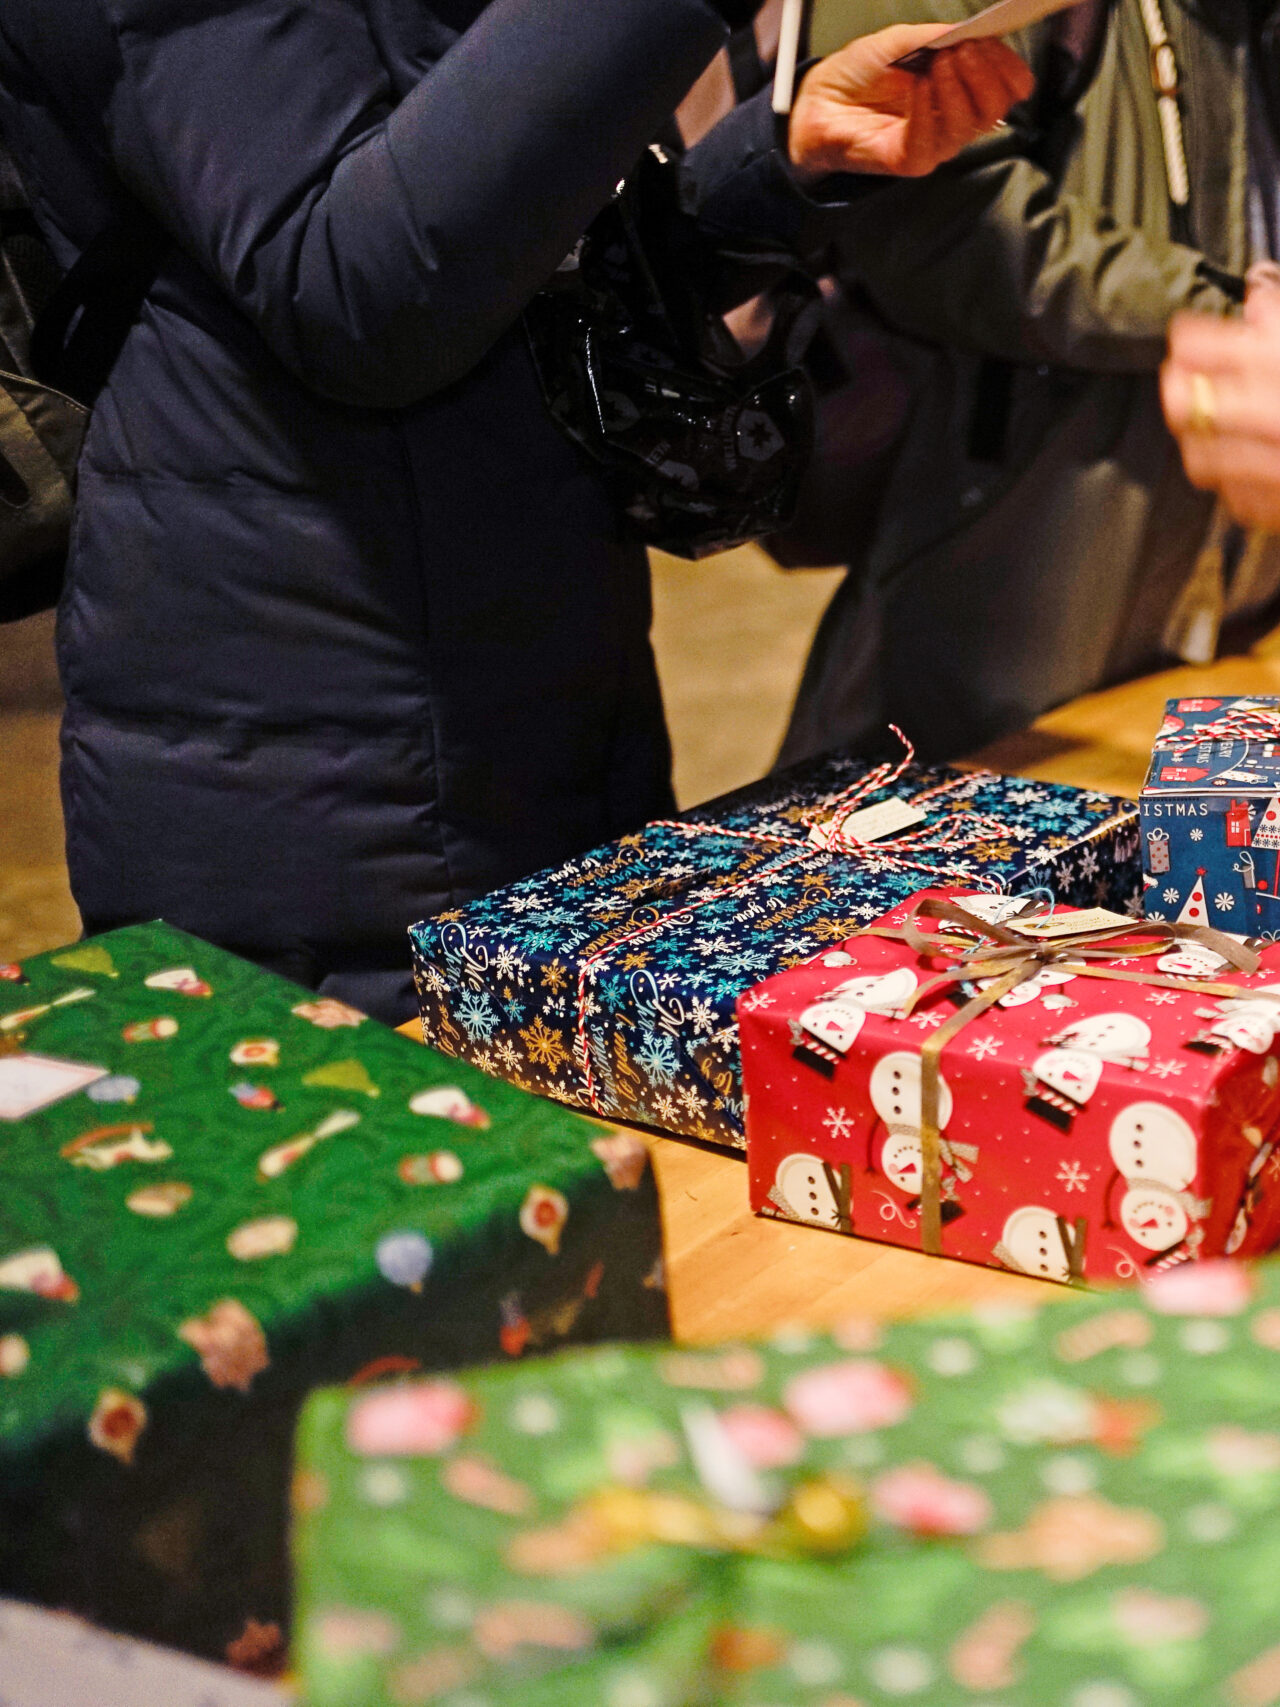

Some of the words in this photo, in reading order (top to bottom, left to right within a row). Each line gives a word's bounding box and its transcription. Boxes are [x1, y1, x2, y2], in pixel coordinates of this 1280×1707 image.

[1140, 803, 1208, 817] ISTMAS
[732, 901, 766, 923] you
[766, 897, 787, 910] to
[781, 897, 851, 928] Merry
